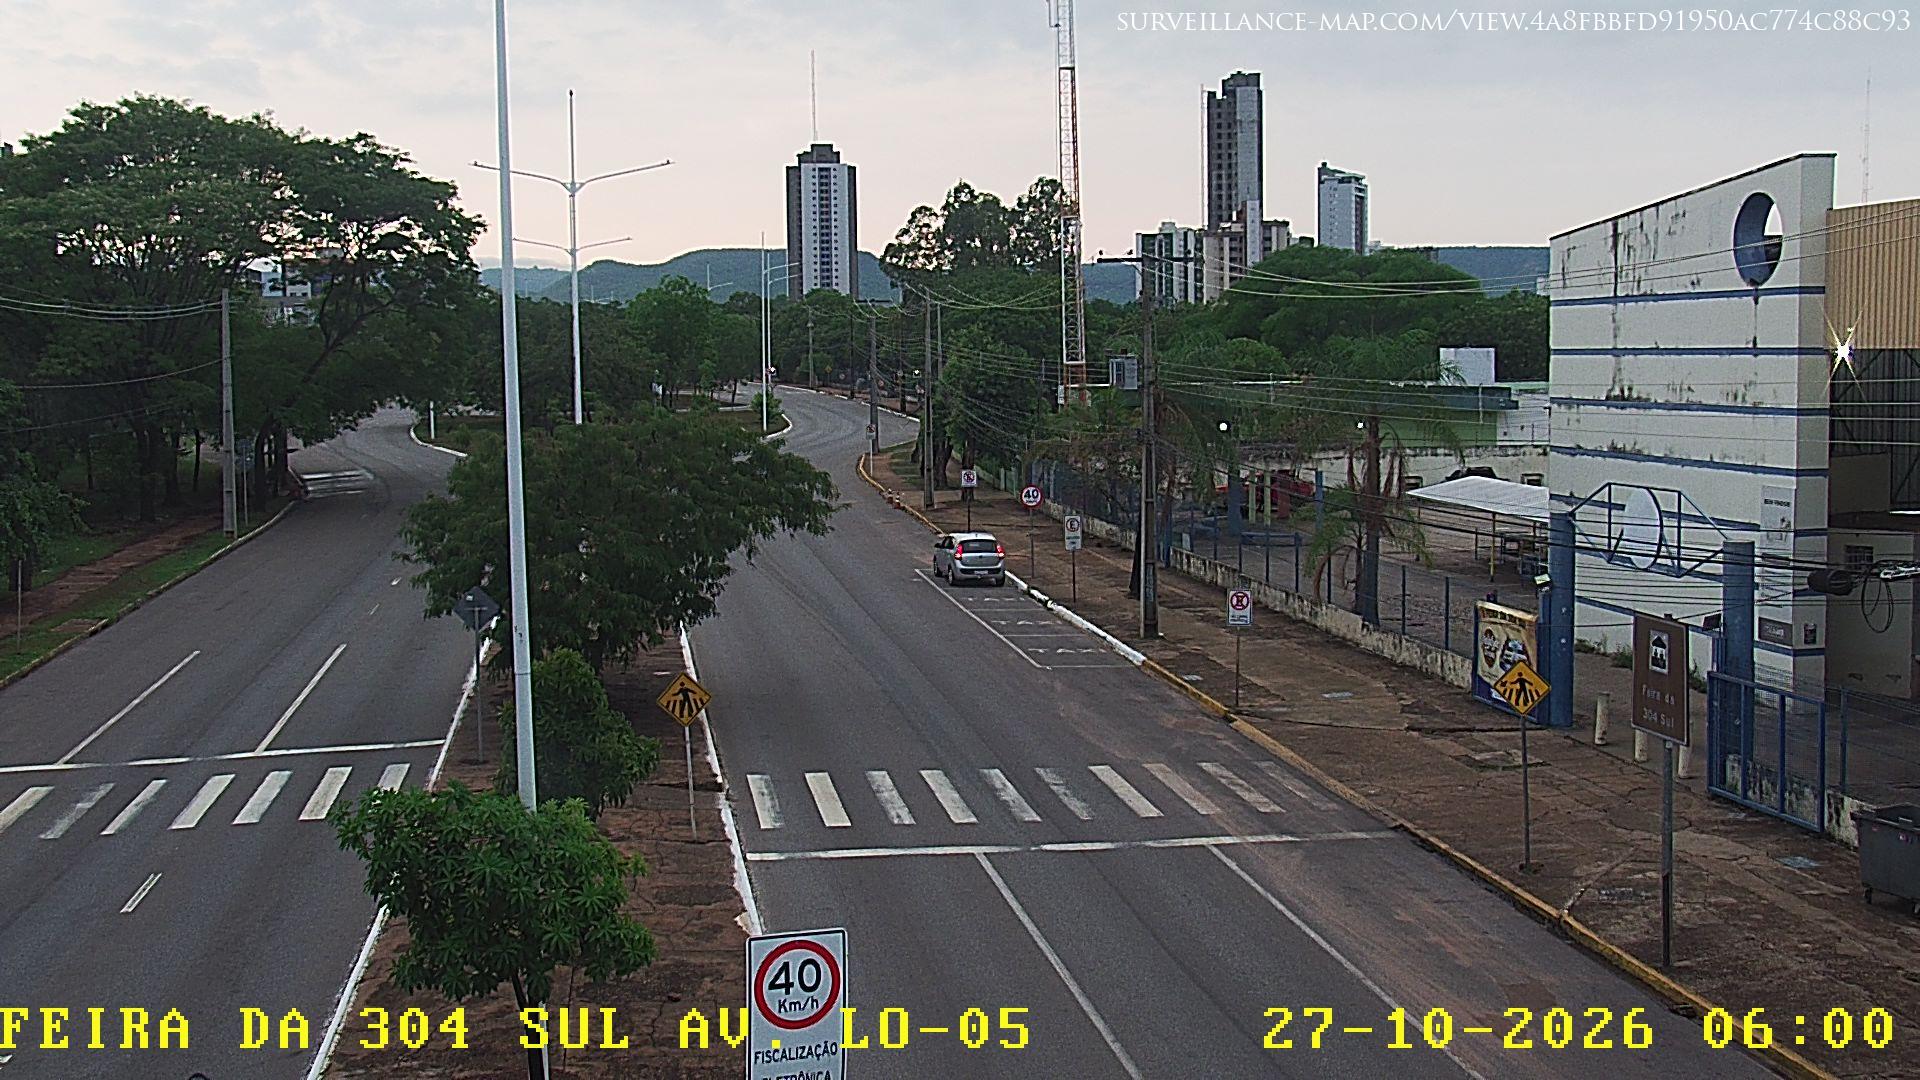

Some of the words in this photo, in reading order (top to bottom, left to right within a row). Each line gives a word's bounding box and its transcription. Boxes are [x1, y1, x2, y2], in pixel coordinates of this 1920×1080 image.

[1024, 489, 1039, 499] 40
[1661, 713, 1674, 728] Sul
[768, 958, 821, 995] 40
[778, 996, 819, 1013] Km/h
[754, 1040, 838, 1064] FISCALIZAÇÃO
